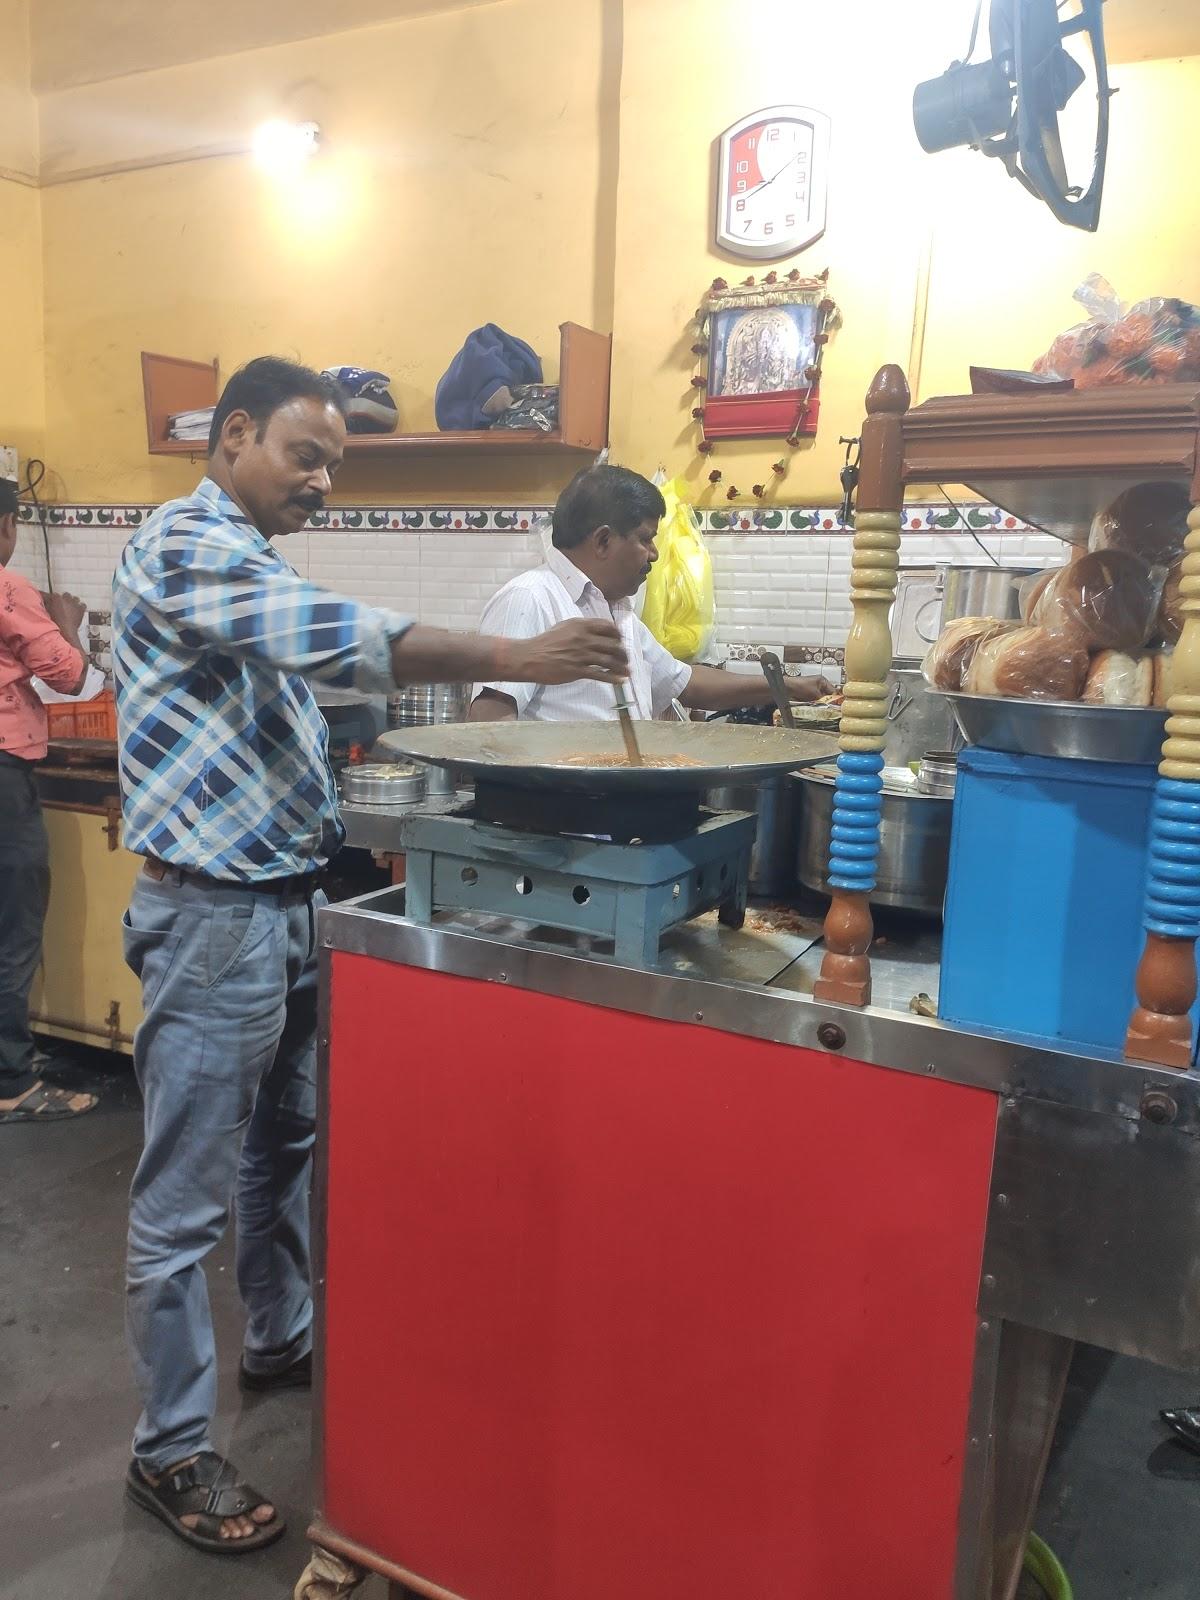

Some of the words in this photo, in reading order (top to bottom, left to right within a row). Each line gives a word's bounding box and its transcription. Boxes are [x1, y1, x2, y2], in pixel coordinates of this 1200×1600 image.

[767, 128, 780, 141] 12
[748, 137, 756, 150] 11
[797, 151, 807, 164] 2
[736, 160, 749, 173] 10
[796, 171, 806, 184] 3
[736, 180, 747, 193] 9
[795, 191, 805, 202] 4
[736, 199, 745, 212] 8
[743, 220, 753, 233] 7
[785, 214, 795, 227] 5
[764, 222, 774, 235] 6
